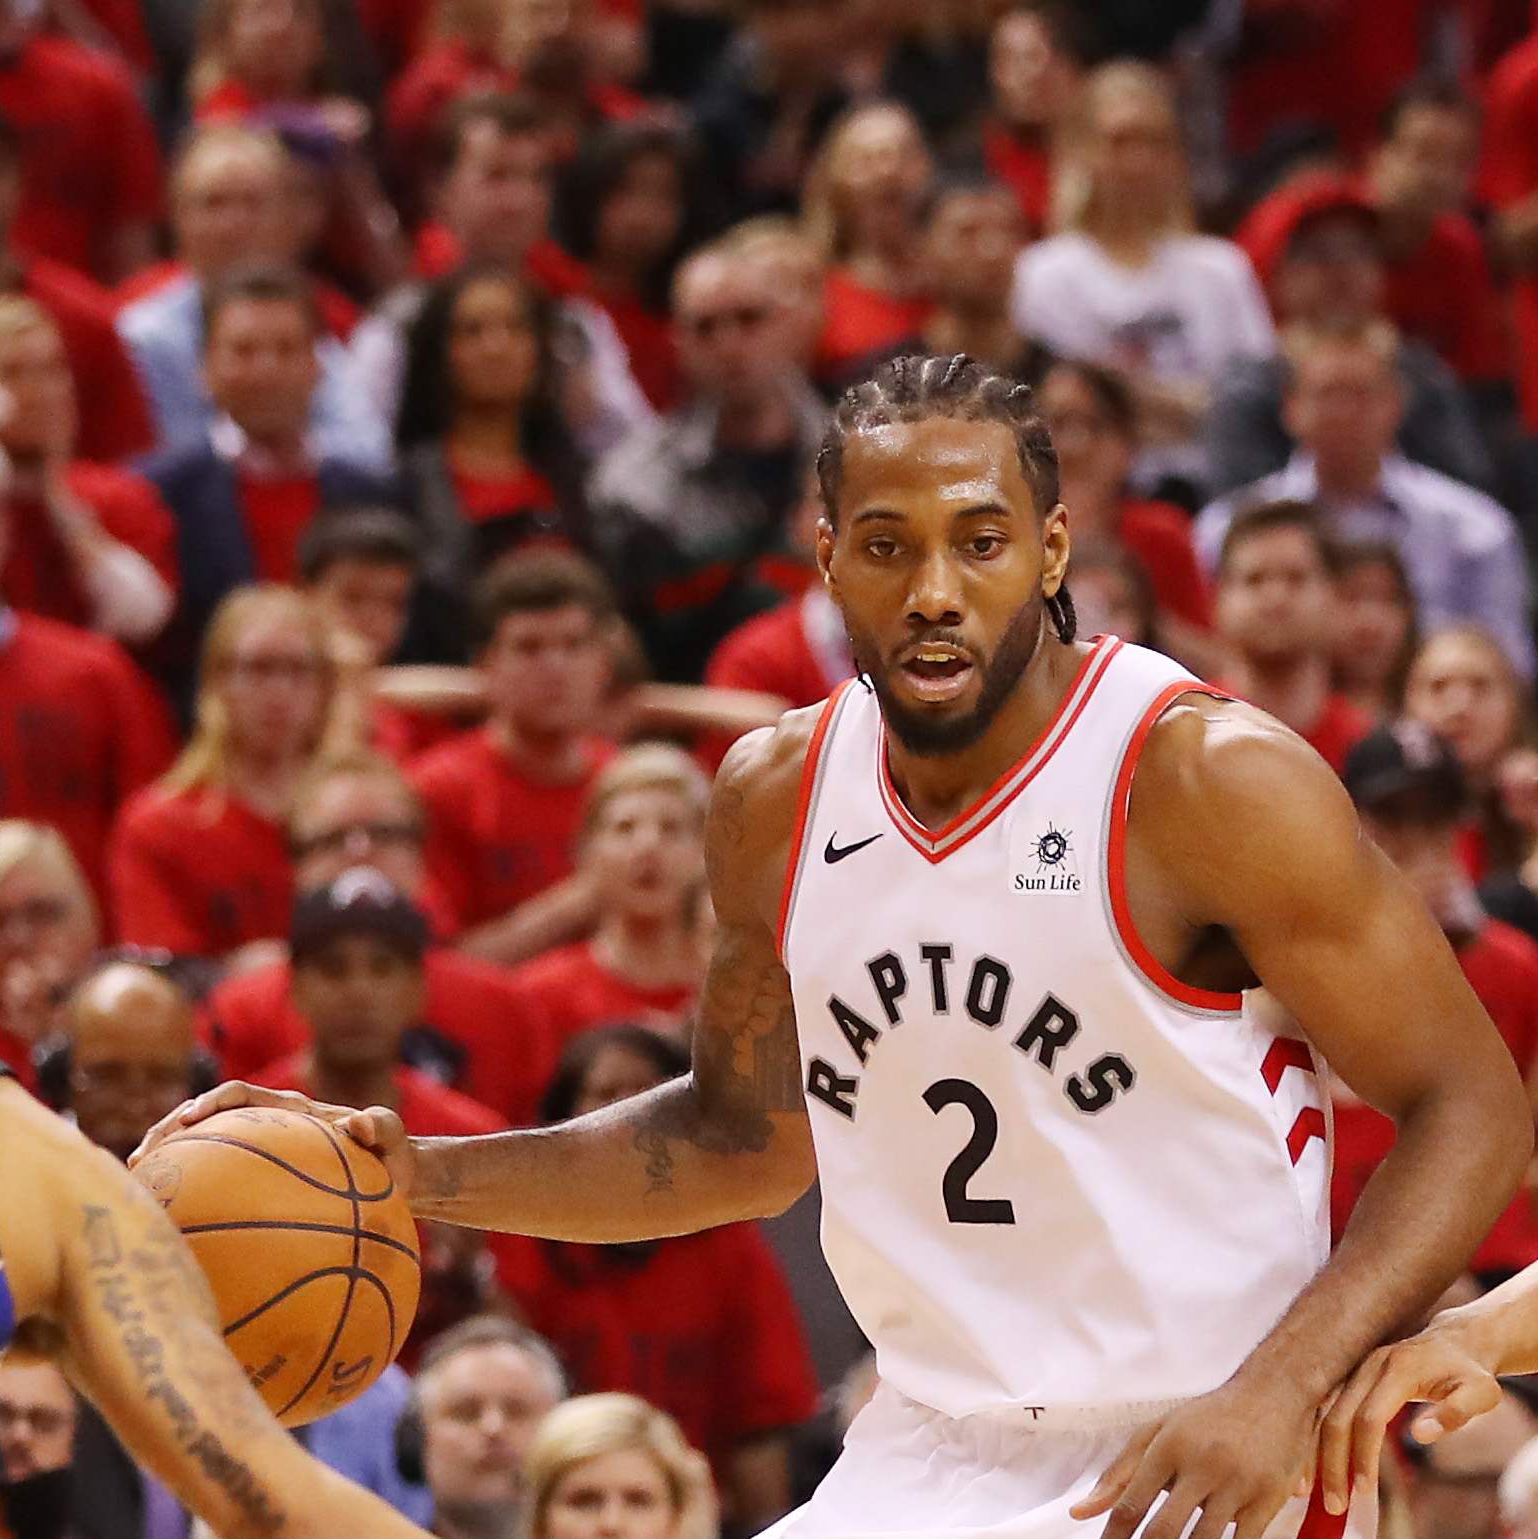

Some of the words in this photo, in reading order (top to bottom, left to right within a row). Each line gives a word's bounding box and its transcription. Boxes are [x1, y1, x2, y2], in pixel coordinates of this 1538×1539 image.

[1014, 873, 1046, 890] Sun
[1050, 873, 1081, 891] Life
[805, 941, 1137, 1122] RAPTORS
[921, 1077, 1016, 1226] 2
